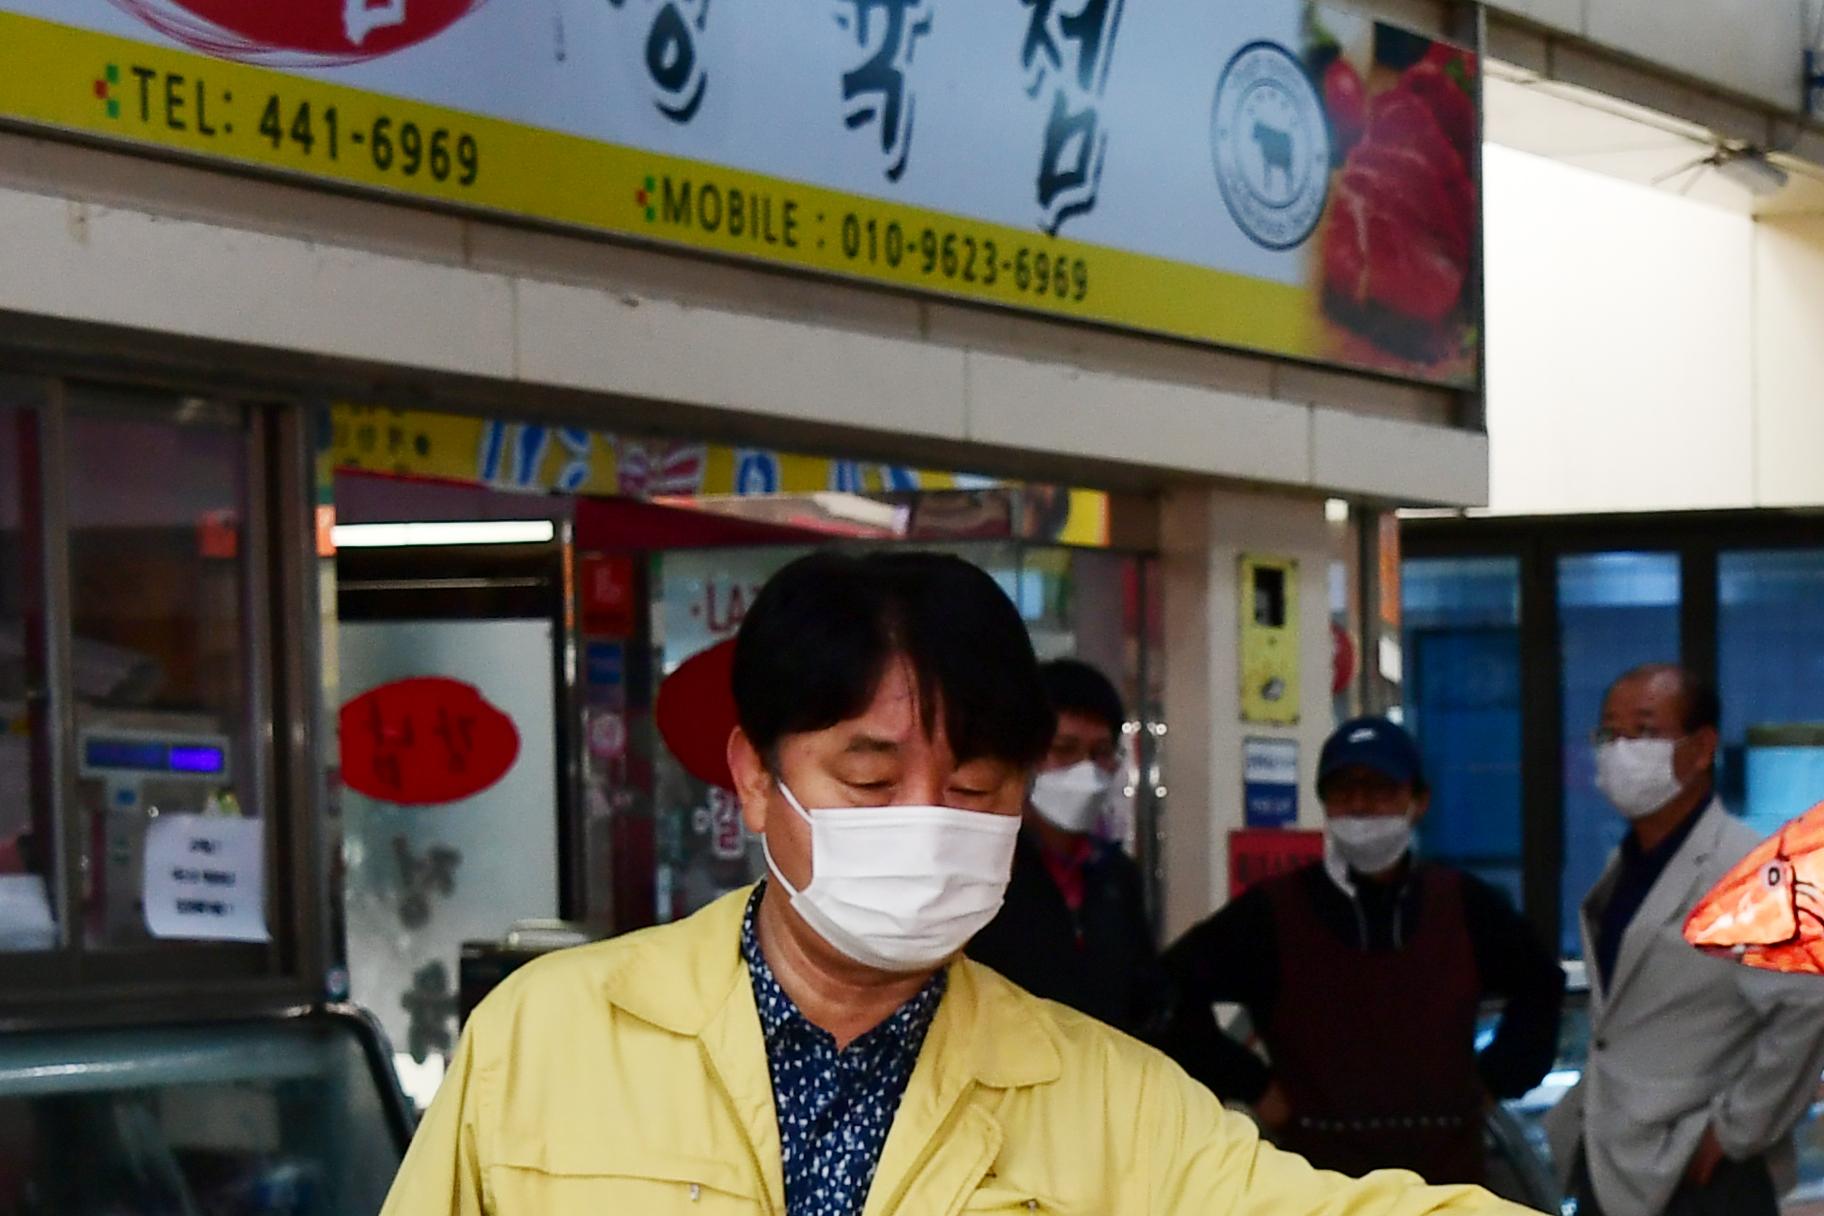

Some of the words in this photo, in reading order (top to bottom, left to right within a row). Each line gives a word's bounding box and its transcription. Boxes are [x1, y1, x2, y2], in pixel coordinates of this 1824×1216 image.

[131, 65, 233, 136] TEL:
[259, 94, 480, 187] 441-6969
[841, 211, 1089, 302] 010-9623-6969
